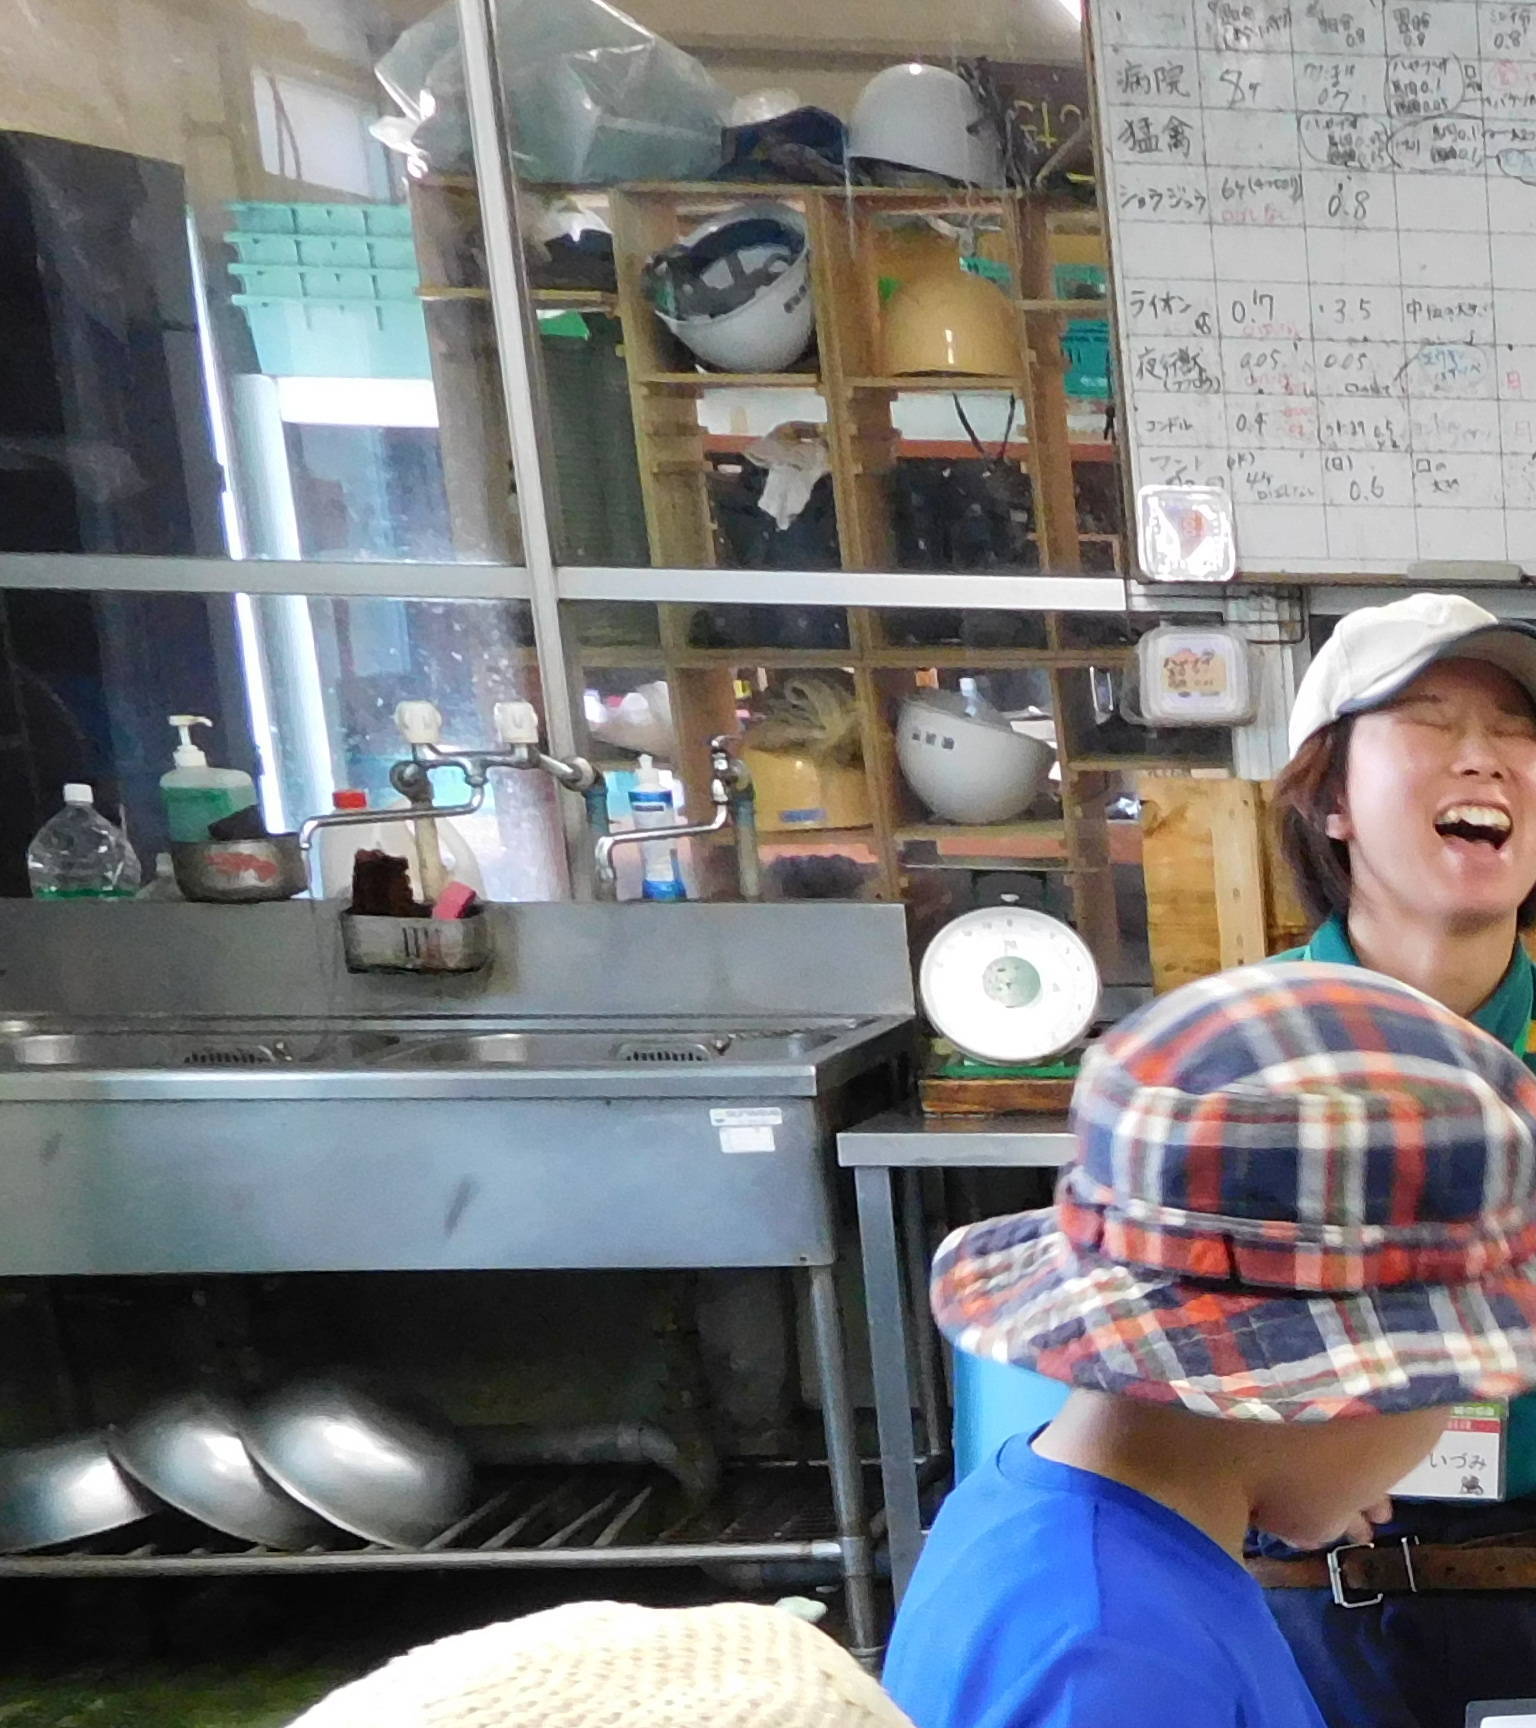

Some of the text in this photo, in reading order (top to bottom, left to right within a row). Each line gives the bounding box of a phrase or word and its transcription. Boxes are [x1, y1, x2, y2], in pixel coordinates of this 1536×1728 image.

[1116, 61, 1191, 99] 病院
[1117, 115, 1194, 158] 猛禽
[1327, 188, 1371, 220] 0.8
[1129, 289, 1193, 318] ライオン
[1348, 475, 1386, 502] 0.6
